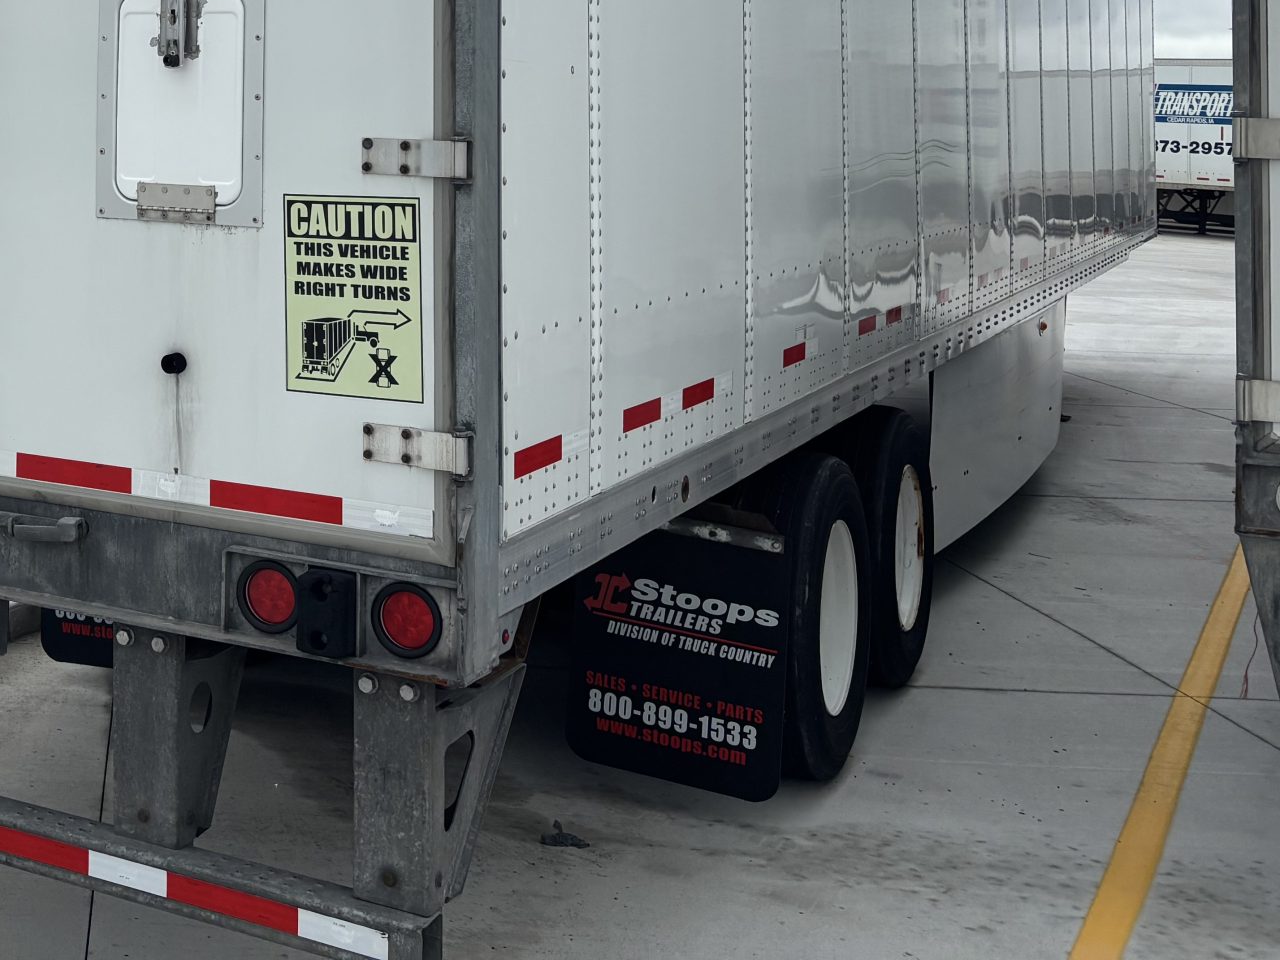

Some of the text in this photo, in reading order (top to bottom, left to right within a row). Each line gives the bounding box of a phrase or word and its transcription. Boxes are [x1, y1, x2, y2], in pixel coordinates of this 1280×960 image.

[290, 202, 414, 240] CAUTION
[294, 241, 410, 261] THIS VEHICLE
[296, 262, 408, 282] MAKES WIDE
[294, 281, 411, 302] RIGHT TURNS
[629, 600, 724, 635] TRAILERS
[630, 578, 780, 628] Stoops
[606, 620, 776, 669] DIVISION OF TRUCK COUNTRY
[586, 670, 764, 724] SALES SERVICE PARTS
[588, 688, 758, 750] 800-899-1533
[596, 716, 747, 766] www.stoops.com
